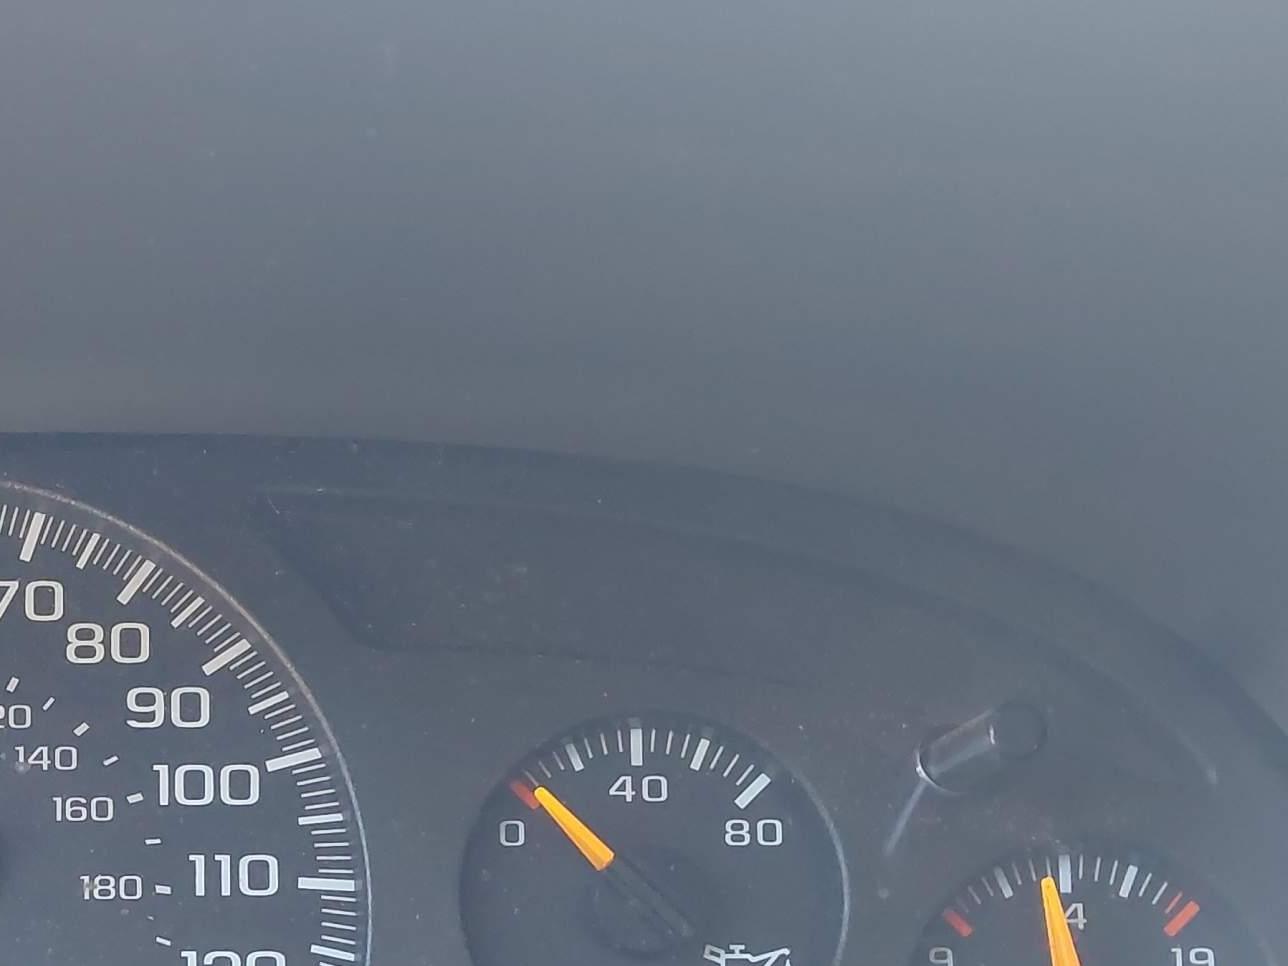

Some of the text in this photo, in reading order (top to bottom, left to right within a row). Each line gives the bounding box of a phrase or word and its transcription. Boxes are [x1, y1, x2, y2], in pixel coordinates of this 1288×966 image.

[66, 622, 150, 664] 80
[126, 686, 210, 728] 90
[14, 745, 78, 771] 140
[152, 764, 260, 806] 100
[608, 775, 668, 802] 40
[52, 796, 114, 822] 160
[499, 820, 525, 847] 0
[724, 819, 783, 846] 80
[79, 874, 143, 900] 180
[188, 854, 279, 897] 110
